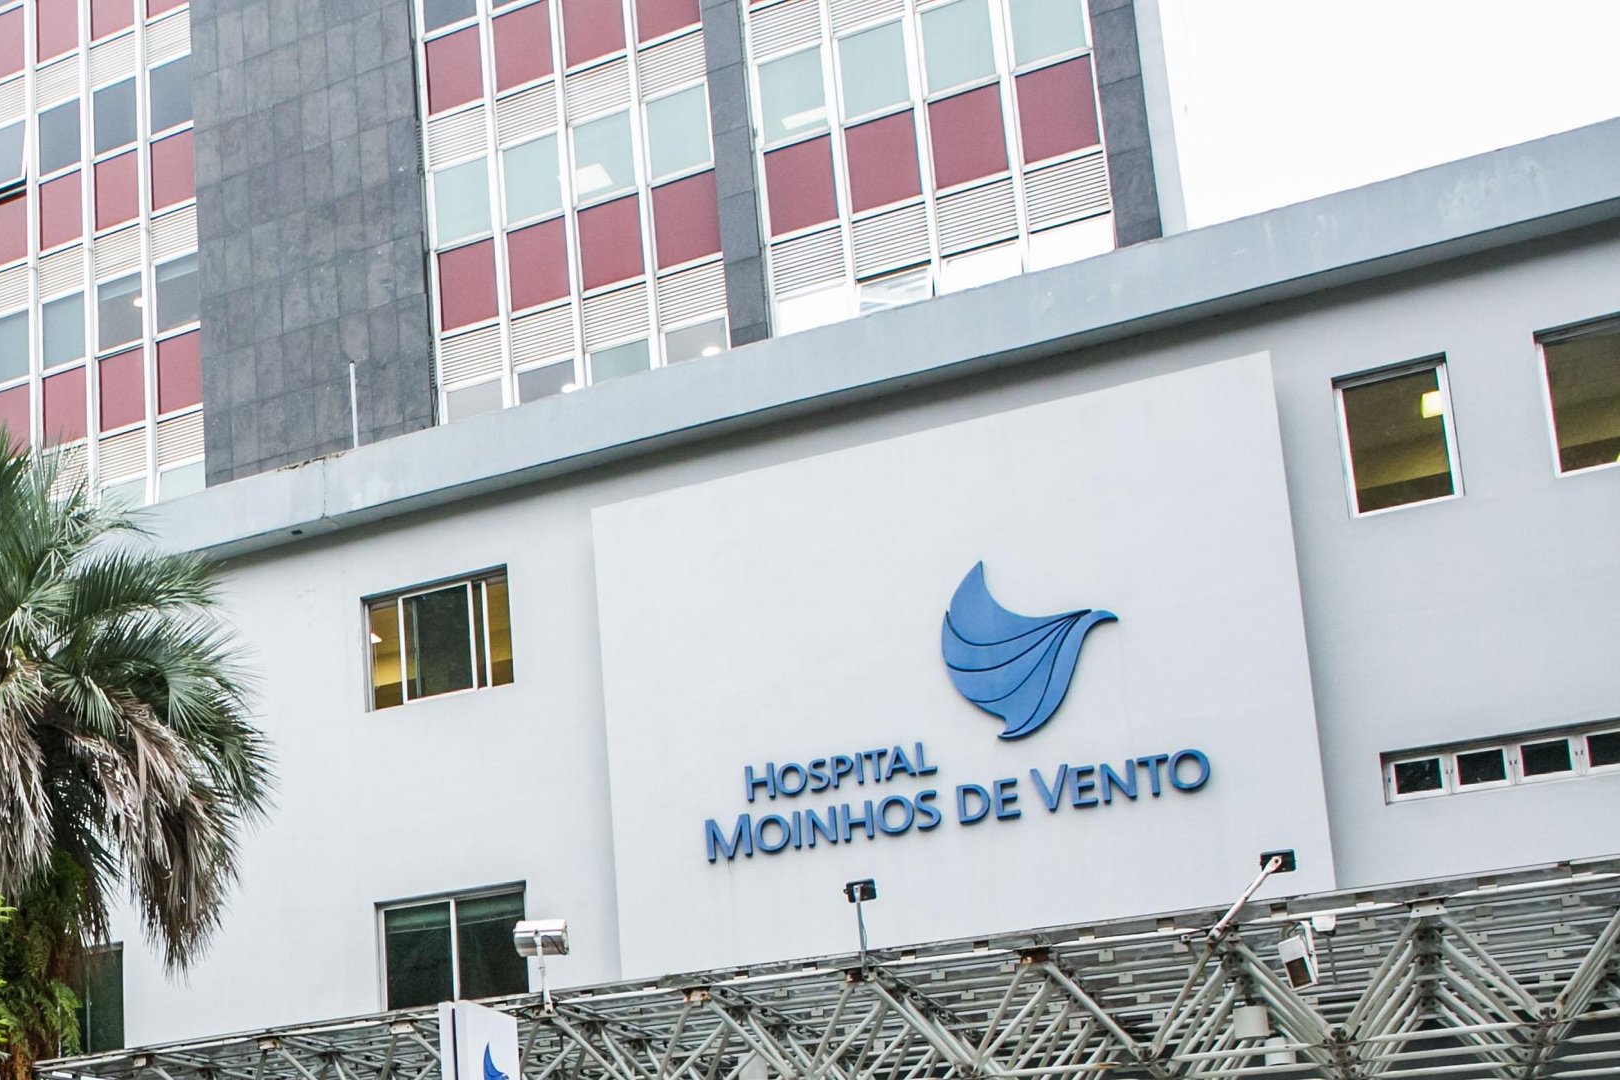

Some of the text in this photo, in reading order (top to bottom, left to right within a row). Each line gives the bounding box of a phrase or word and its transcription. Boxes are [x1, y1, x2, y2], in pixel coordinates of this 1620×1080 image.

[704, 749, 1211, 864] MOINHOS DE VENTO
[744, 742, 938, 801] HOSPITAL
